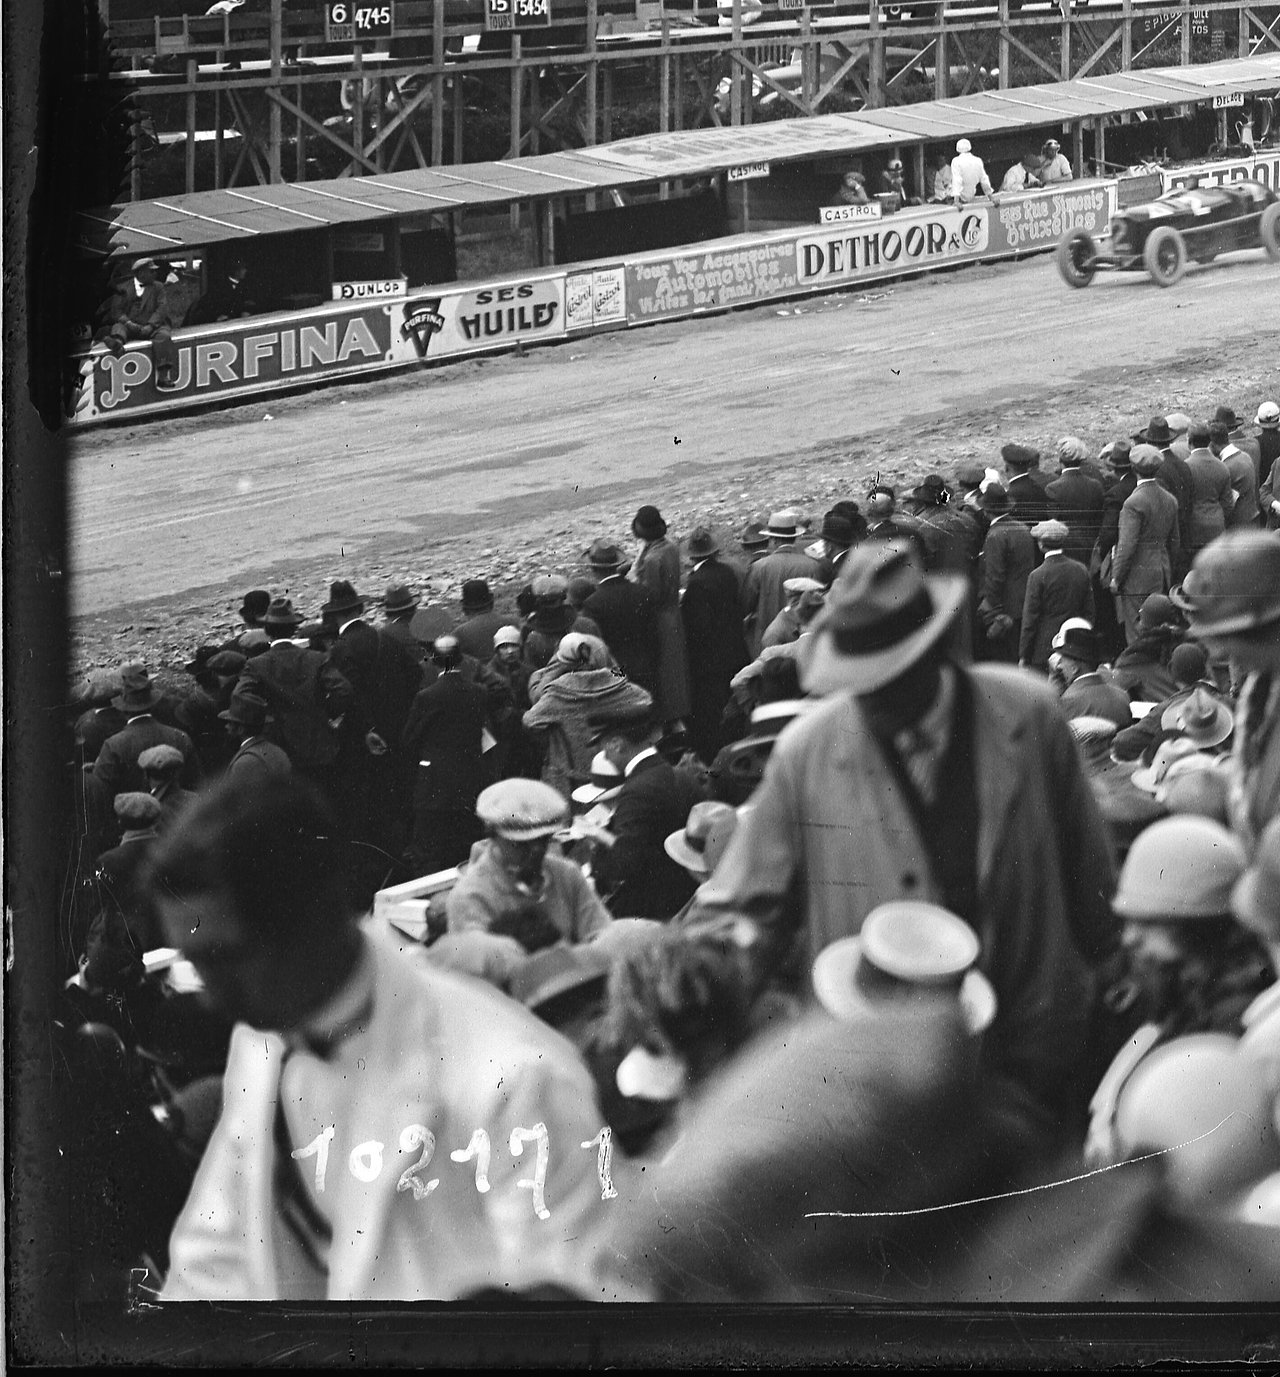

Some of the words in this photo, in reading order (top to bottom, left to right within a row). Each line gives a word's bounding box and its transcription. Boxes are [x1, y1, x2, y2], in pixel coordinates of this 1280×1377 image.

[332, 3, 347, 23] 6
[1193, 10, 1209, 19] UILE
[1216, 93, 1242, 107] DELAGE
[730, 164, 768, 179] CASTROL
[825, 206, 877, 221] CASTROL
[1023, 199, 1048, 222] Rue
[1052, 190, 1104, 219] Simonis
[1005, 208, 1096, 246] Bruxelles
[703, 245, 794, 270] Accessoires
[803, 222, 946, 278] DETHOOR
[948, 231, 961, 250] &
[656, 260, 779, 298] Automobiles
[341, 283, 400, 298] DUNLOP
[475, 284, 534, 305] SES
[693, 288, 714, 304] les
[404, 312, 442, 330] PURFINA
[460, 301, 558, 340] HUILES
[101, 318, 381, 409] PURFINA
